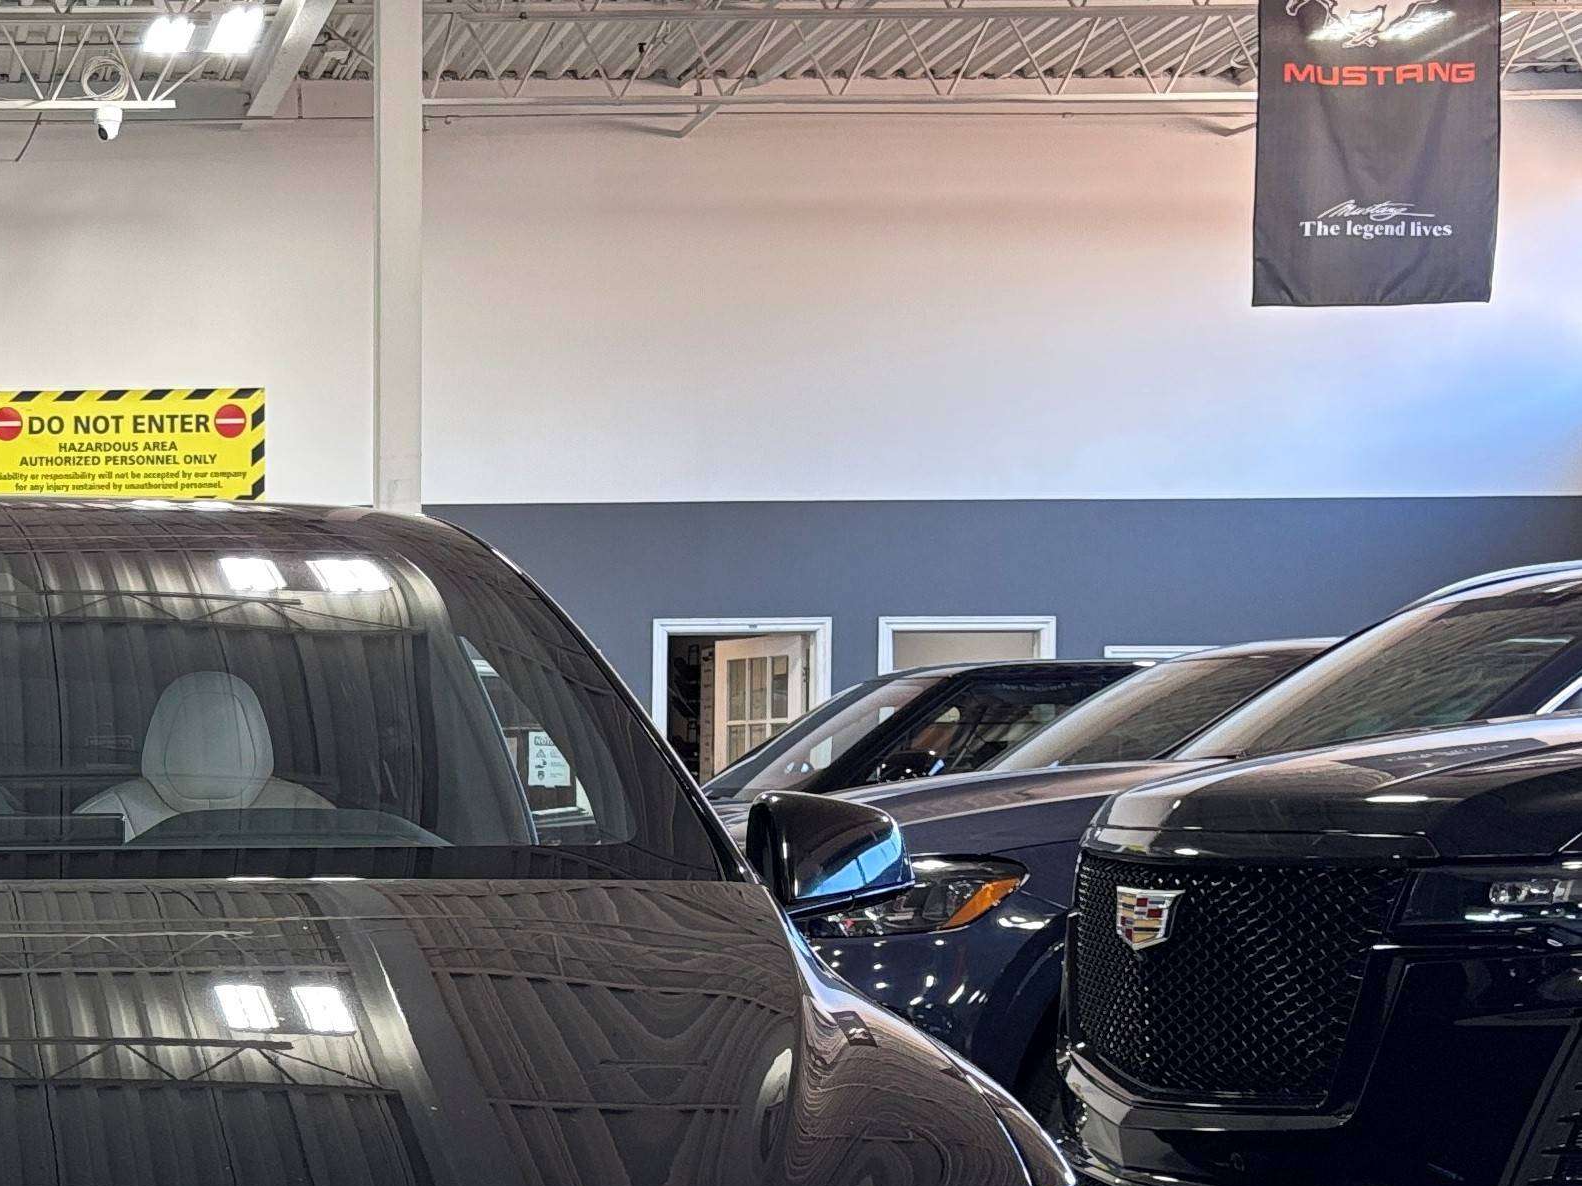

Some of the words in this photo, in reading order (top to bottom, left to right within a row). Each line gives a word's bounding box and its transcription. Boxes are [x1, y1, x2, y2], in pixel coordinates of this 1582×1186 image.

[1283, 62, 1476, 86] MUSTANG
[1299, 220, 1341, 237] The
[1346, 220, 1406, 240] legend
[1410, 221, 1453, 237] lives
[28, 415, 65, 435] DO
[73, 415, 124, 434] NOT
[133, 414, 210, 433] ENTER
[58, 441, 138, 453] HAZARDOUS
[143, 441, 178, 451] AREA
[19, 455, 101, 467] AUTHORIZED
[105, 454, 180, 466] PERSONNEL
[184, 454, 217, 465] ONLY
[41, 471, 95, 481] responsibility
[98, 471, 112, 479] will
[131, 471, 141, 479] be
[143, 471, 179, 481] accepted
[182, 471, 192, 480] by
[210, 471, 247, 480] company
[15, 483, 27, 491] for
[47, 483, 69, 493] injury
[72, 483, 110, 491] sustained
[113, 482, 122, 492] by
[125, 481, 178, 490] unauthorized
